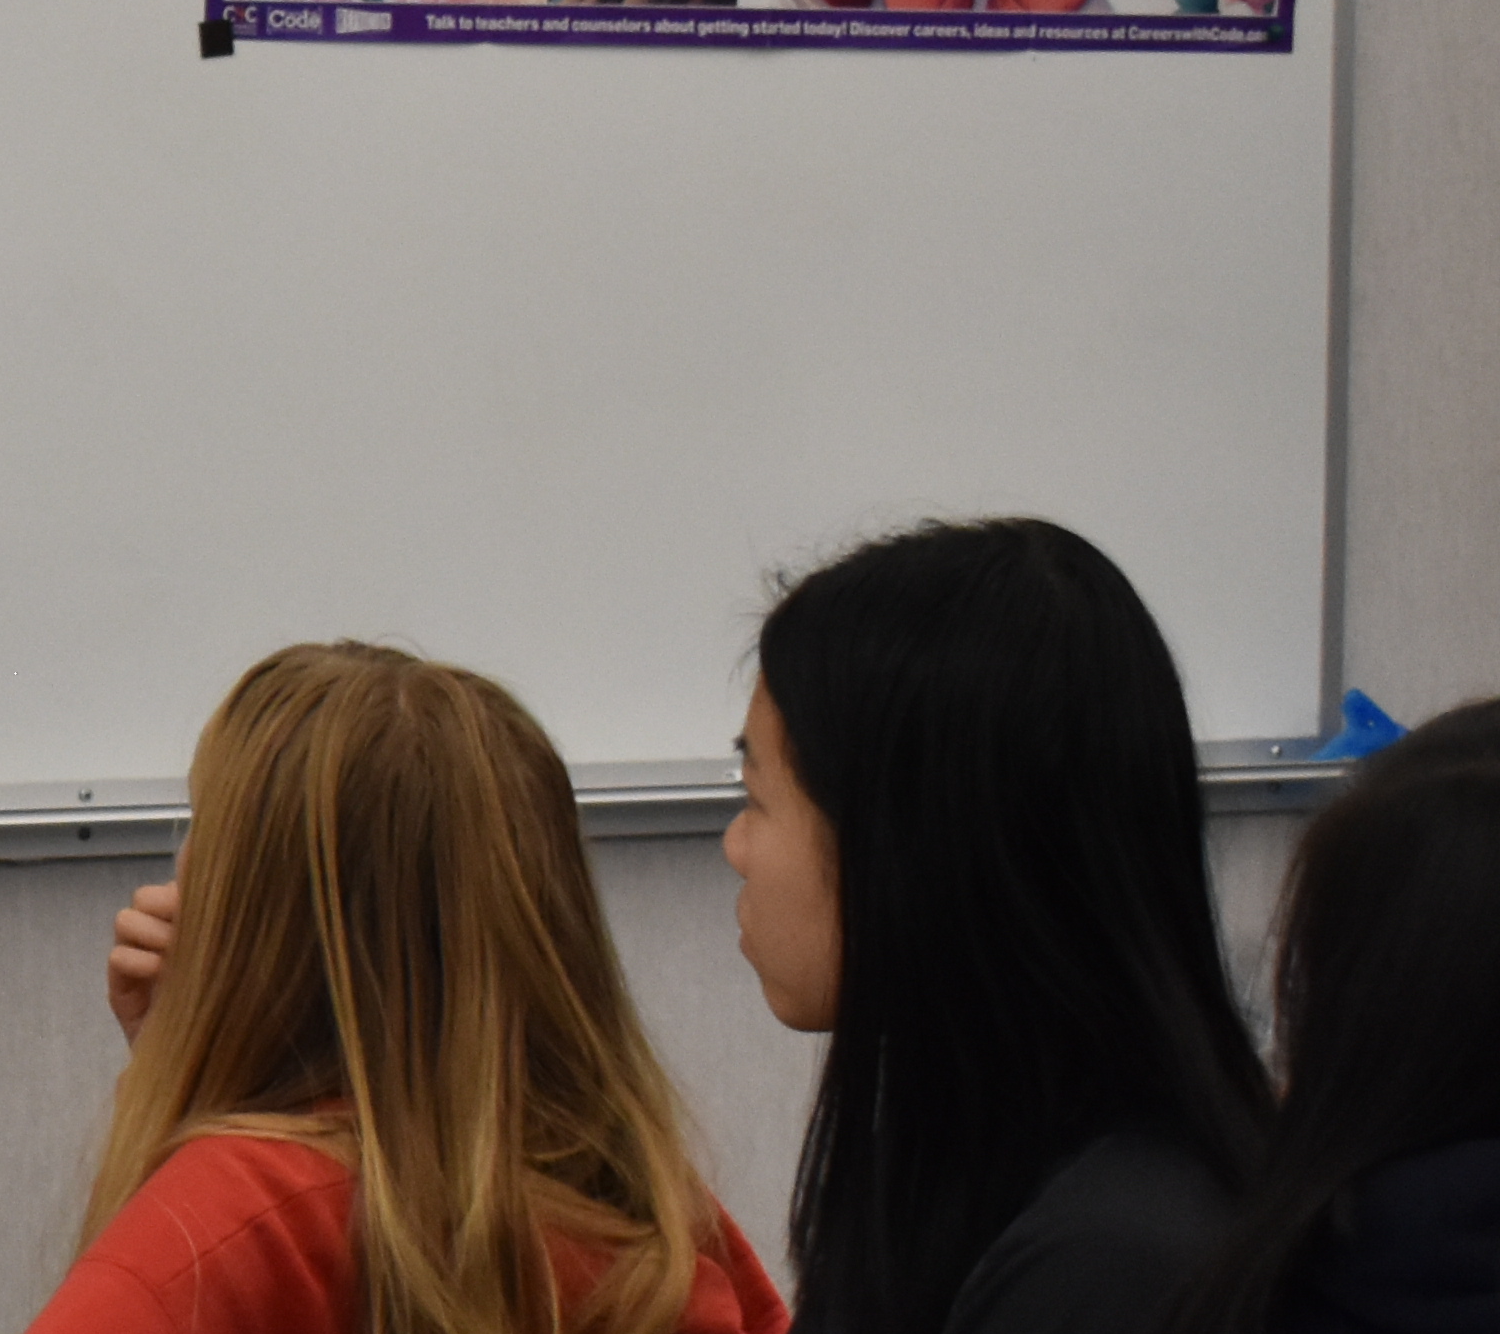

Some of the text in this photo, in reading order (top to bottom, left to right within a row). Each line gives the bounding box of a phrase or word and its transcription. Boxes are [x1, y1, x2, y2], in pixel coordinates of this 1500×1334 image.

[426, 14, 456, 30] Talk
[459, 16, 474, 30] to
[475, 16, 540, 32] teachers
[542, 17, 569, 32] and
[572, 17, 651, 33] counselors
[654, 18, 694, 34] about
[697, 19, 750, 38] getting
[753, 20, 800, 36] started
[803, 20, 847, 39] today!
[850, 21, 911, 37] Discover
[913, 23, 971, 39] careers,
[973, 22, 1010, 38] ideas
[1013, 23, 1037, 39] and
[1039, 25, 1109, 41] resources
[1111, 26, 1127, 40] at
